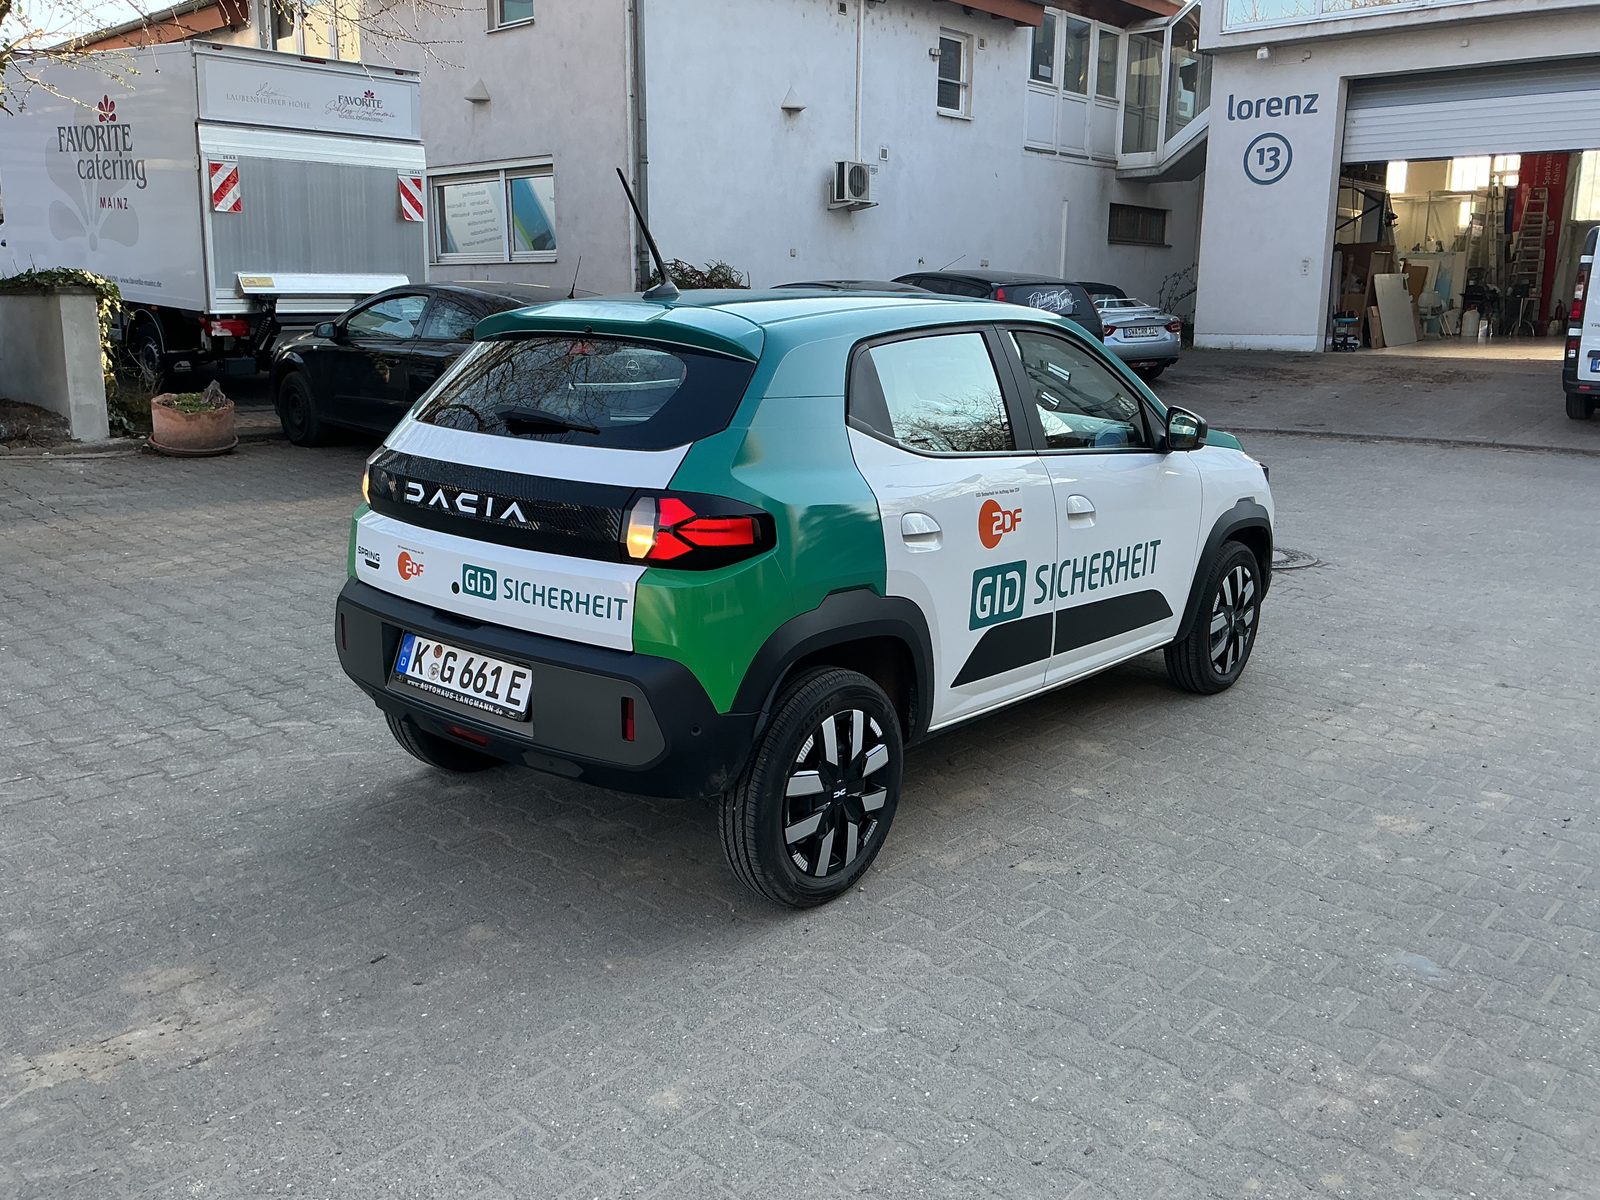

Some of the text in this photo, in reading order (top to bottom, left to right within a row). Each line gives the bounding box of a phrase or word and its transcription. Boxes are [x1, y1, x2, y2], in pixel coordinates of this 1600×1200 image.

[338, 95, 383, 109] FAVORITE
[1227, 94, 1319, 121] lorenz
[57, 124, 133, 153] FAVORITE
[77, 152, 147, 190] catering
[1256, 146, 1281, 173] 13
[99, 196, 128, 210] MAINZ
[405, 481, 527, 523] DACIA
[992, 508, 1022, 536] ZDF
[358, 545, 380, 562] SPRING
[405, 560, 424, 576] ZDF
[1033, 539, 1161, 605] SICHERHEIT
[503, 577, 628, 621] SICHERHEIT
